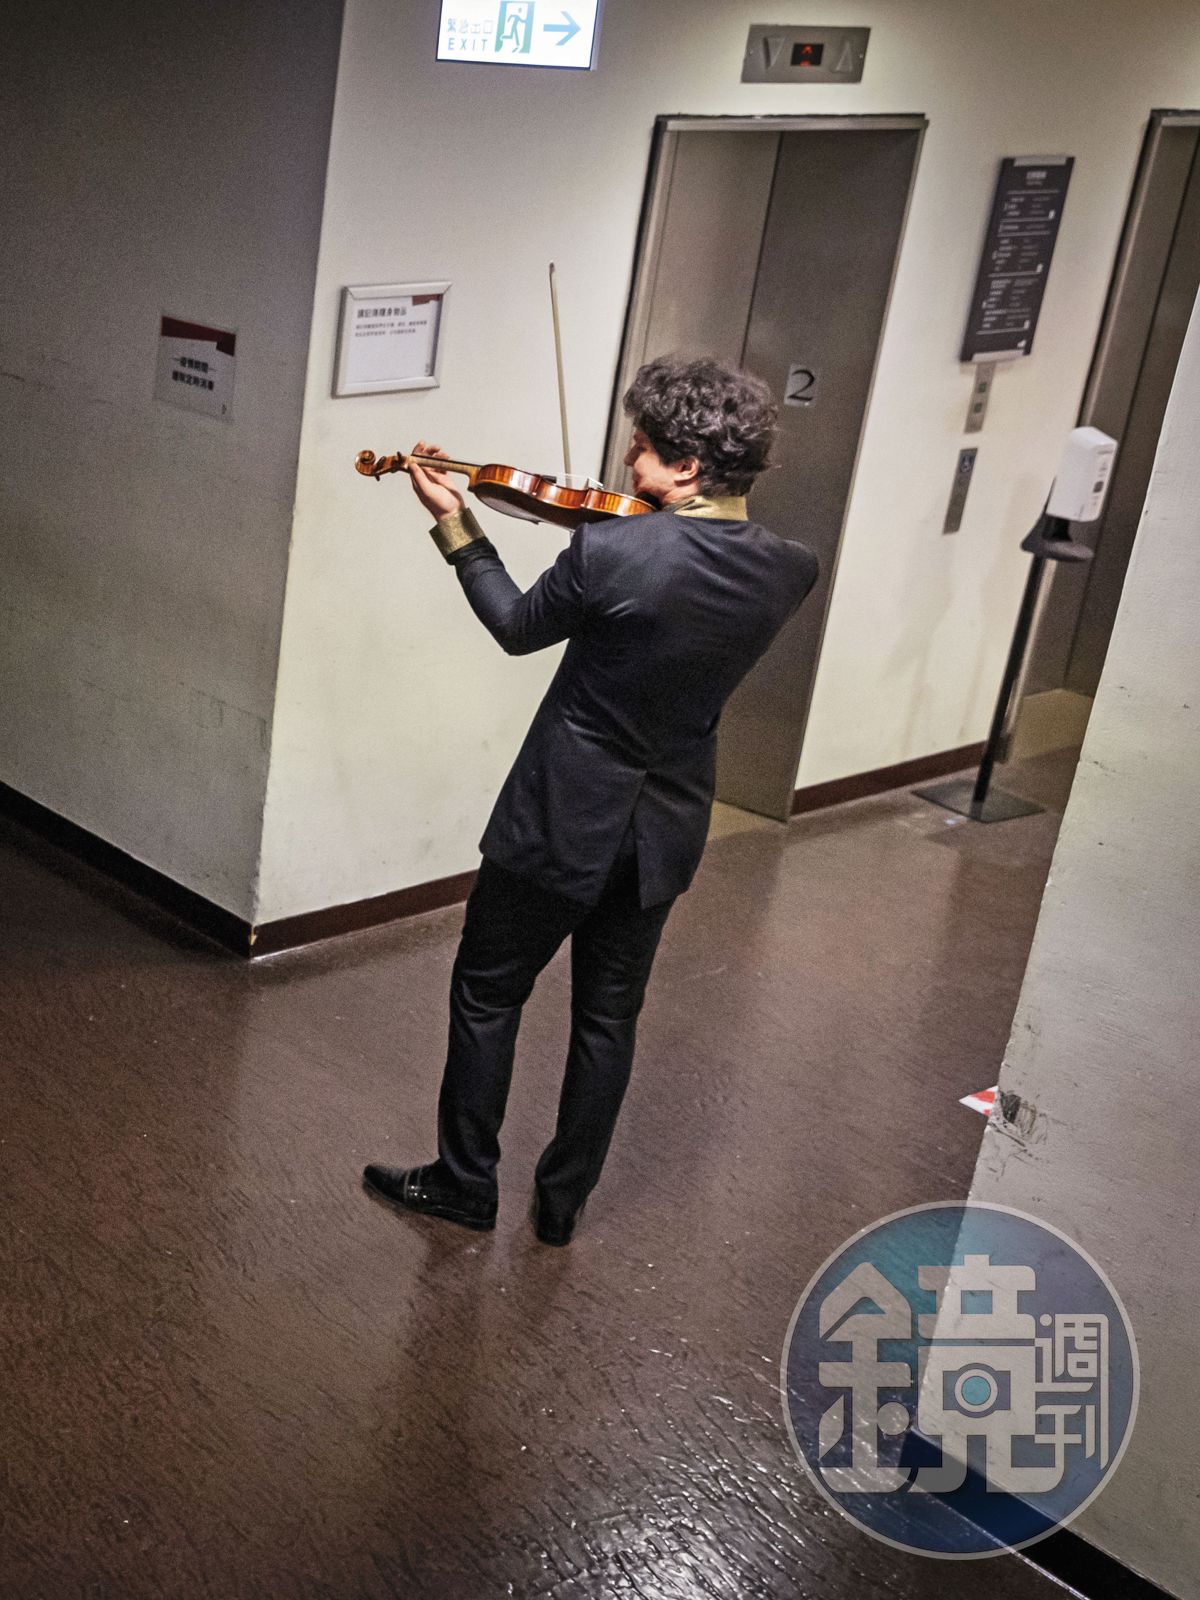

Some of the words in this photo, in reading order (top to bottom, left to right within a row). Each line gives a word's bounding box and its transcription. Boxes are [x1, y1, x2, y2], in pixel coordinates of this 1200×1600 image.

[447, 18, 493, 34] 緊急出口
[448, 37, 488, 51] EXIT
[787, 369, 815, 401] 2
